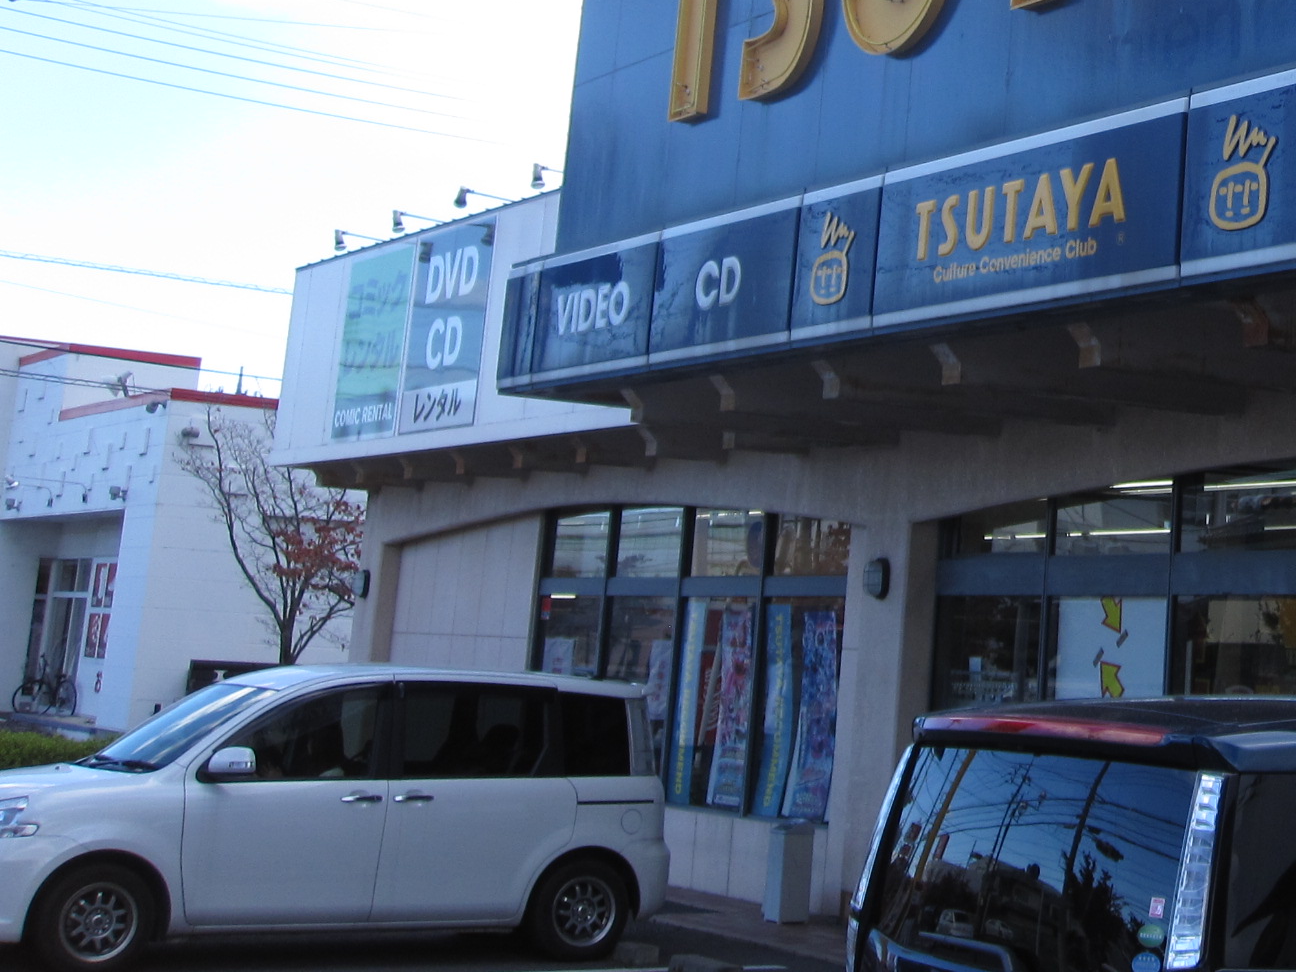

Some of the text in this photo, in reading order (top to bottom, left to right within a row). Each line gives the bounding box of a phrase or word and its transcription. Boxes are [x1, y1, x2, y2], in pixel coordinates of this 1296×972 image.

[916, 157, 1126, 261] TSUTAYA
[425, 246, 479, 305] DVD
[696, 256, 741, 311] CD
[933, 237, 1097, 284] Culture Convenience Club
[557, 281, 630, 336] VIDEO
[426, 315, 463, 370] CD
[334, 403, 393, 428] COMIC RENTAL
[413, 388, 462, 424] レンタル
